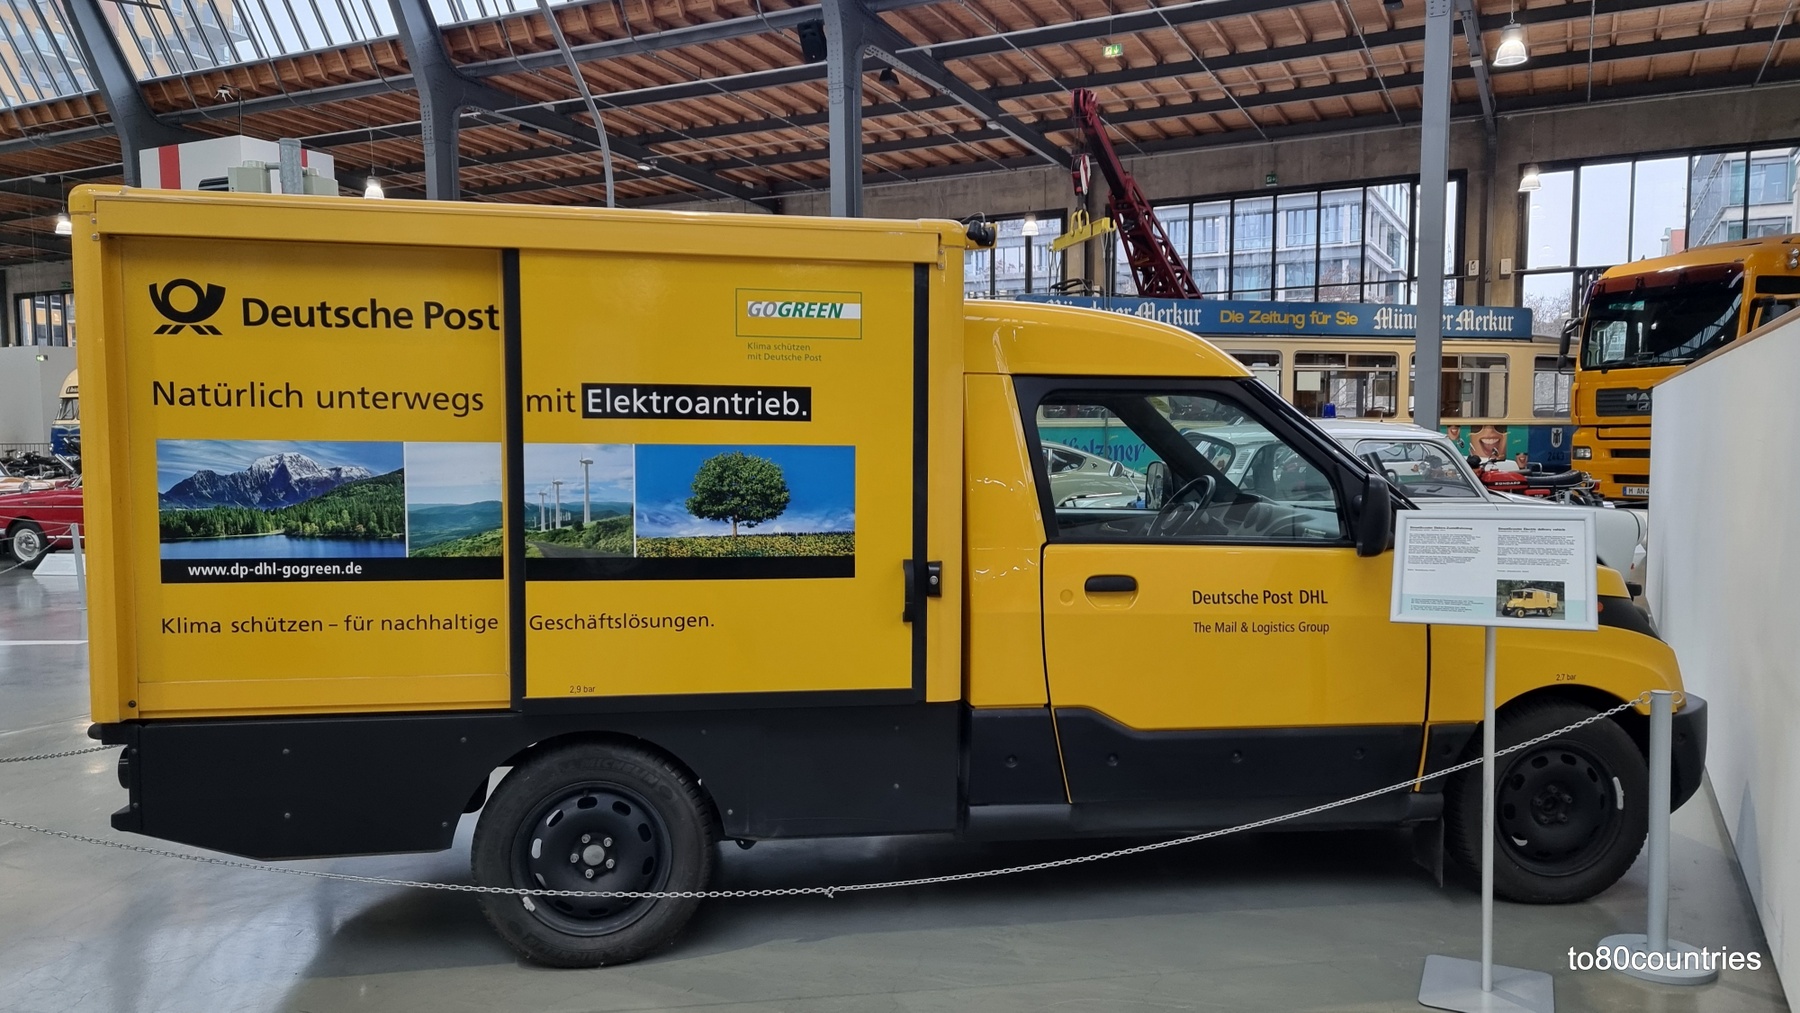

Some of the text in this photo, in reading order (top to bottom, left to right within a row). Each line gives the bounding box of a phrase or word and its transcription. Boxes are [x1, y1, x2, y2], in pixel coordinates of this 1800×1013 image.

[242, 298, 500, 331] Deutsche Post
[747, 301, 844, 319] GOGREEN
[1220, 310, 1359, 329] Die Zeitung für Sie
[1455, 309, 1515, 332] Merkur
[747, 342, 811, 352] Klima schützen
[747, 353, 822, 362] mit Deutsche Post
[152, 380, 808, 417] Natürlich unterwegs mit Elektroantrieb.
[1626, 393, 1653, 401] MA
[188, 562, 363, 578] www.dp-dhl-gogreen.de
[1192, 589, 1328, 605] Deutsche Post DHL
[161, 616, 221, 634] Klima
[231, 616, 323, 634] schützen
[344, 614, 374, 632] für
[381, 613, 499, 635] nachhaltige
[528, 612, 715, 632] Geschäftslösungen.
[1193, 621, 1330, 635] The Mail & Logistics Group
[1566, 673, 1577, 681] bar
[569, 684, 596, 694] 2,9 bar
